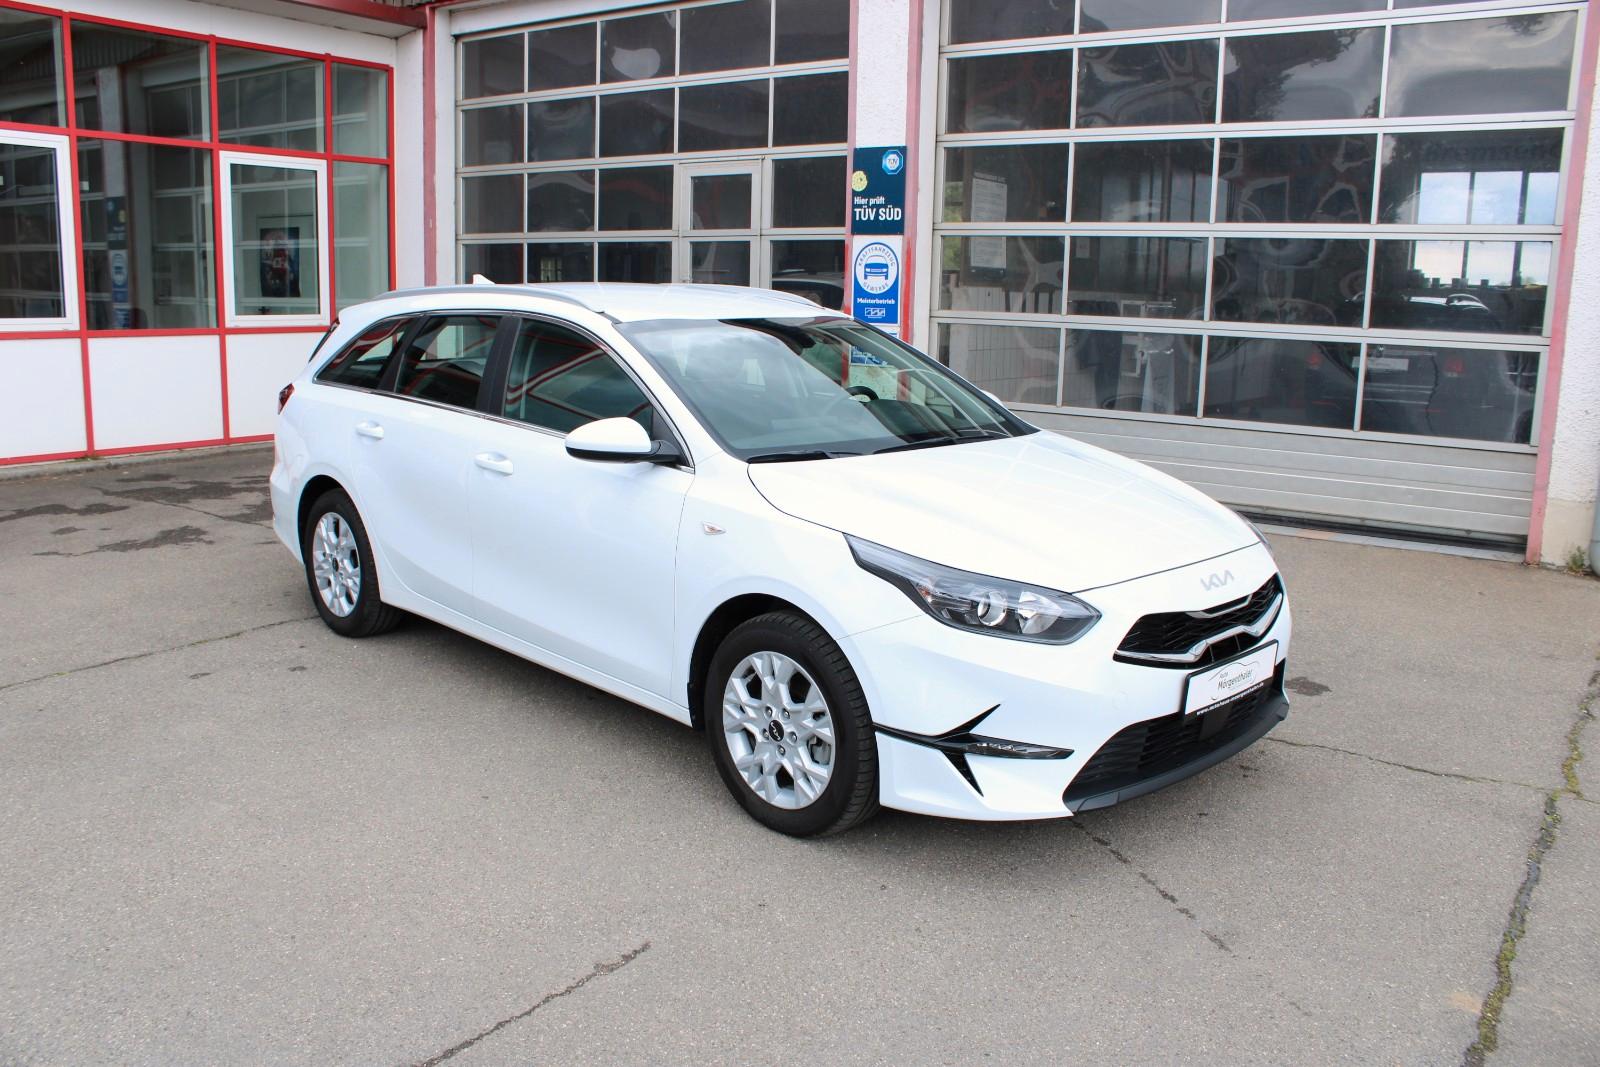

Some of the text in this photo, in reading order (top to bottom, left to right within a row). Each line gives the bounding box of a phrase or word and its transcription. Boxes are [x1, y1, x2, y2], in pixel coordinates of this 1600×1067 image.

[854, 196, 885, 207] Hier prüft
[854, 204, 902, 221] TÜV SÜD
[857, 297, 896, 305] Meisterbetrieb
[1200, 569, 1235, 591] KIA
